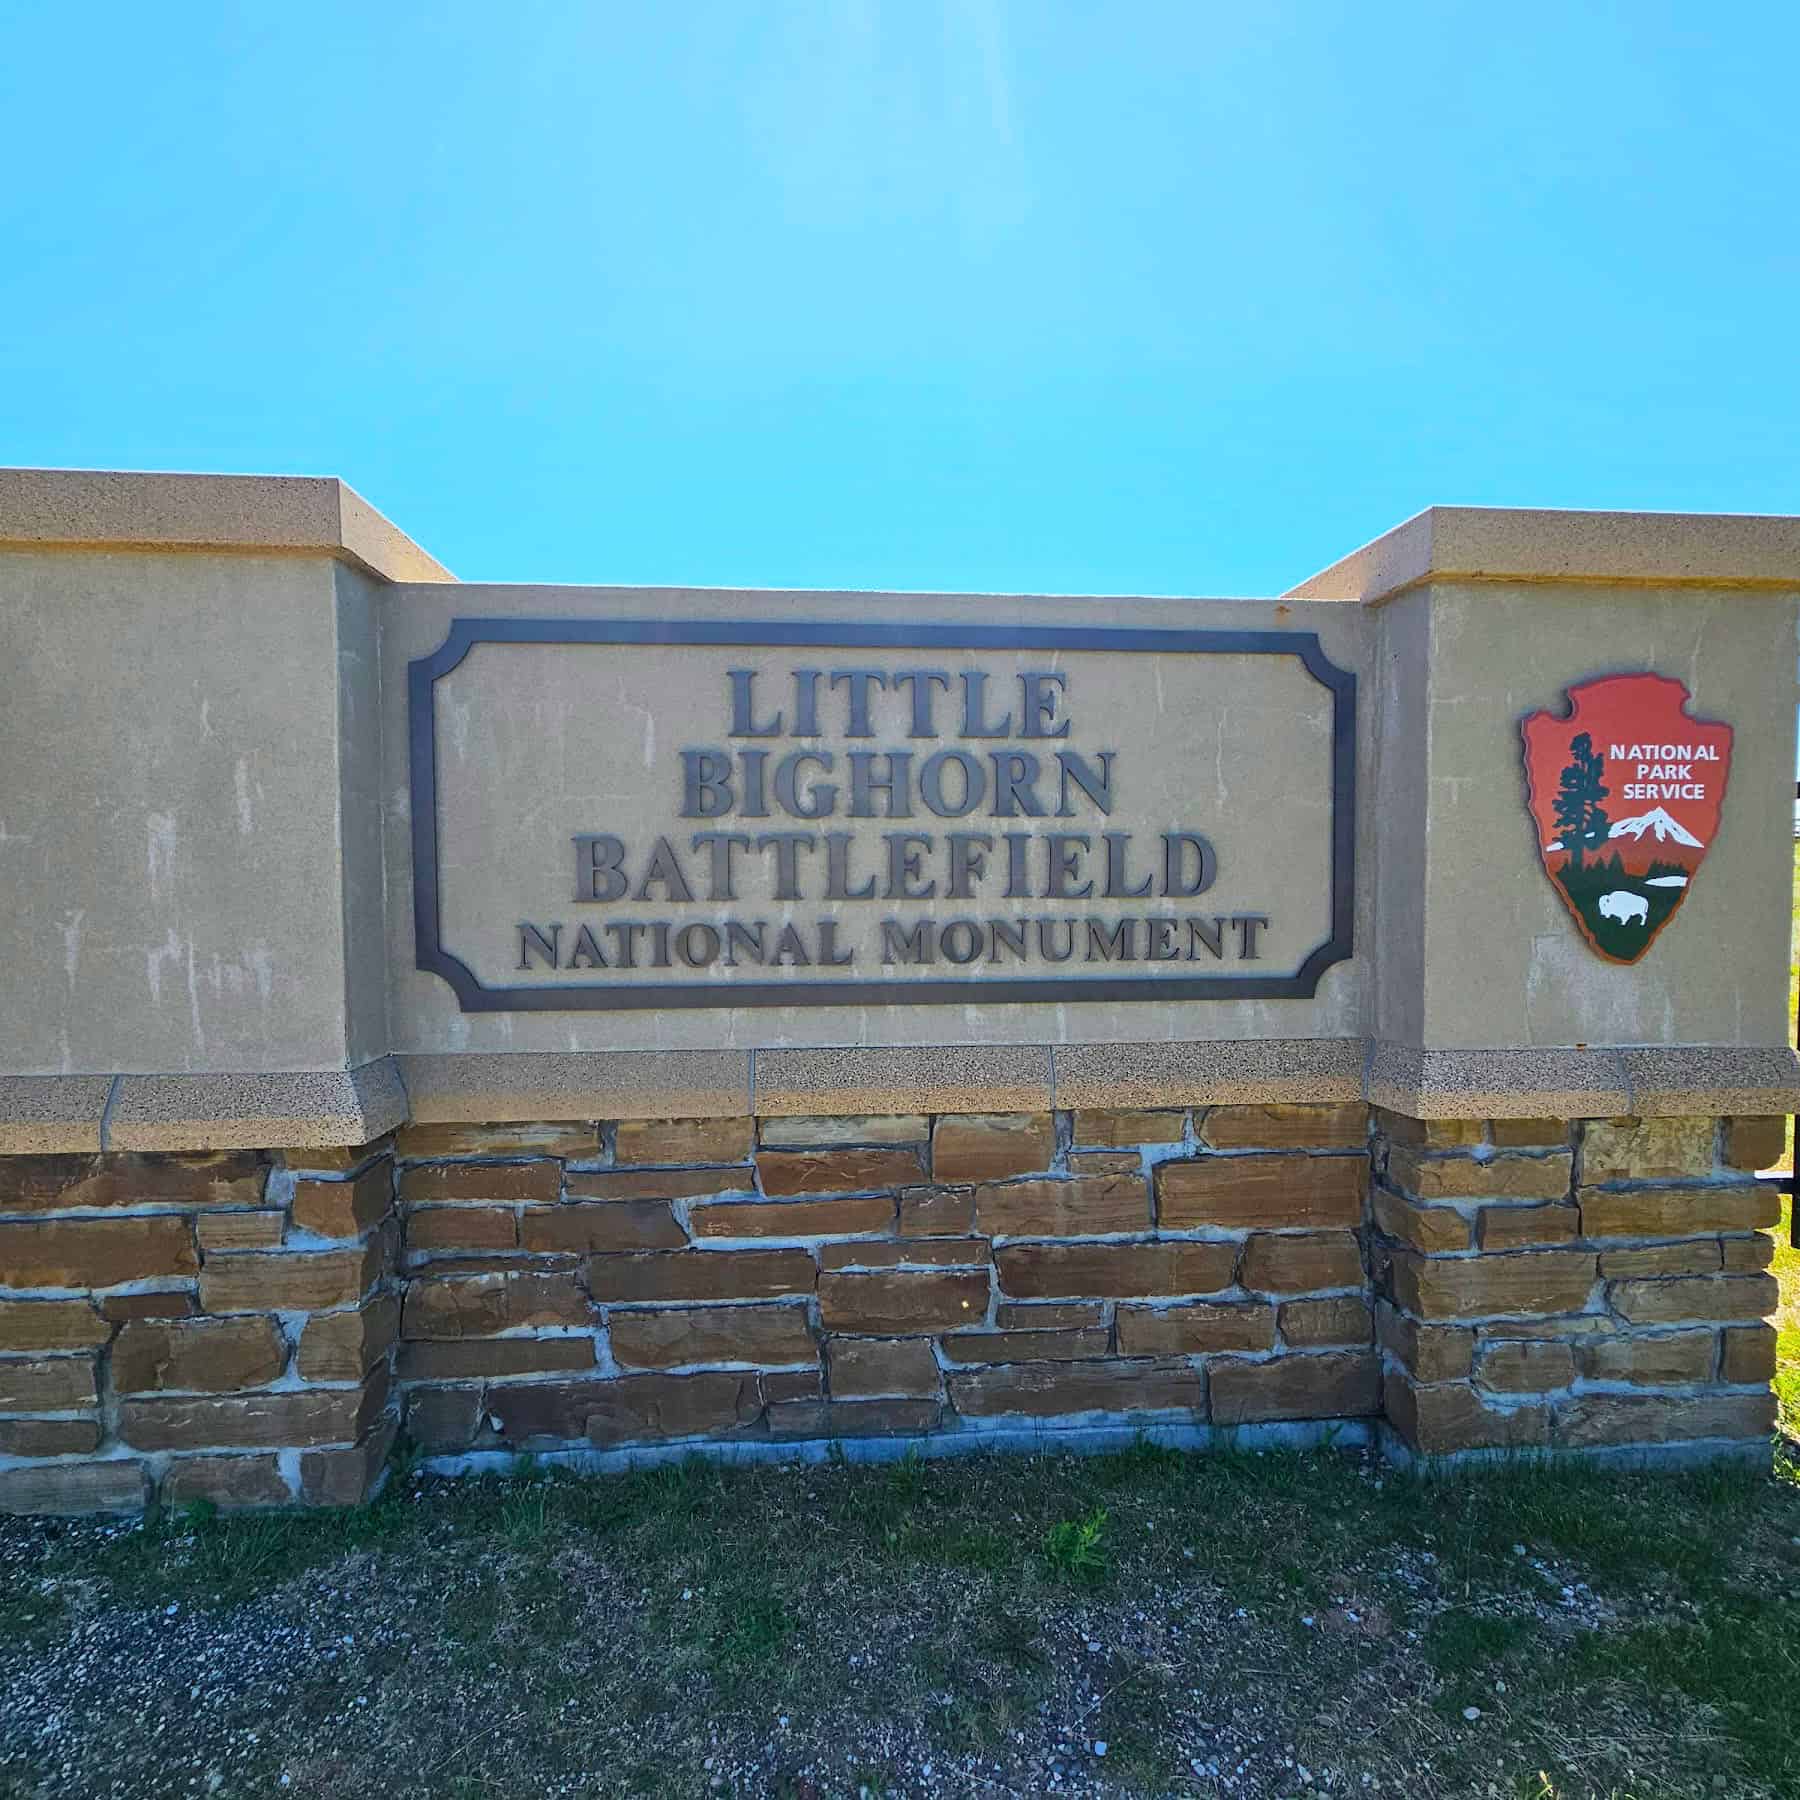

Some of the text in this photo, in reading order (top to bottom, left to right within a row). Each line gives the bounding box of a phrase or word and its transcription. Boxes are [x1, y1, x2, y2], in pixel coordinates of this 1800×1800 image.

[727, 668, 1071, 740] LITTLE
[1610, 744, 1720, 761] NATIONAL
[1637, 764, 1693, 780] PARK
[678, 749, 1117, 819] BIGHORN
[1623, 783, 1705, 800] SERVICE
[571, 832, 1218, 903] BATTLEFIELD
[514, 916, 1269, 971] NATIONAL MONUMENT
